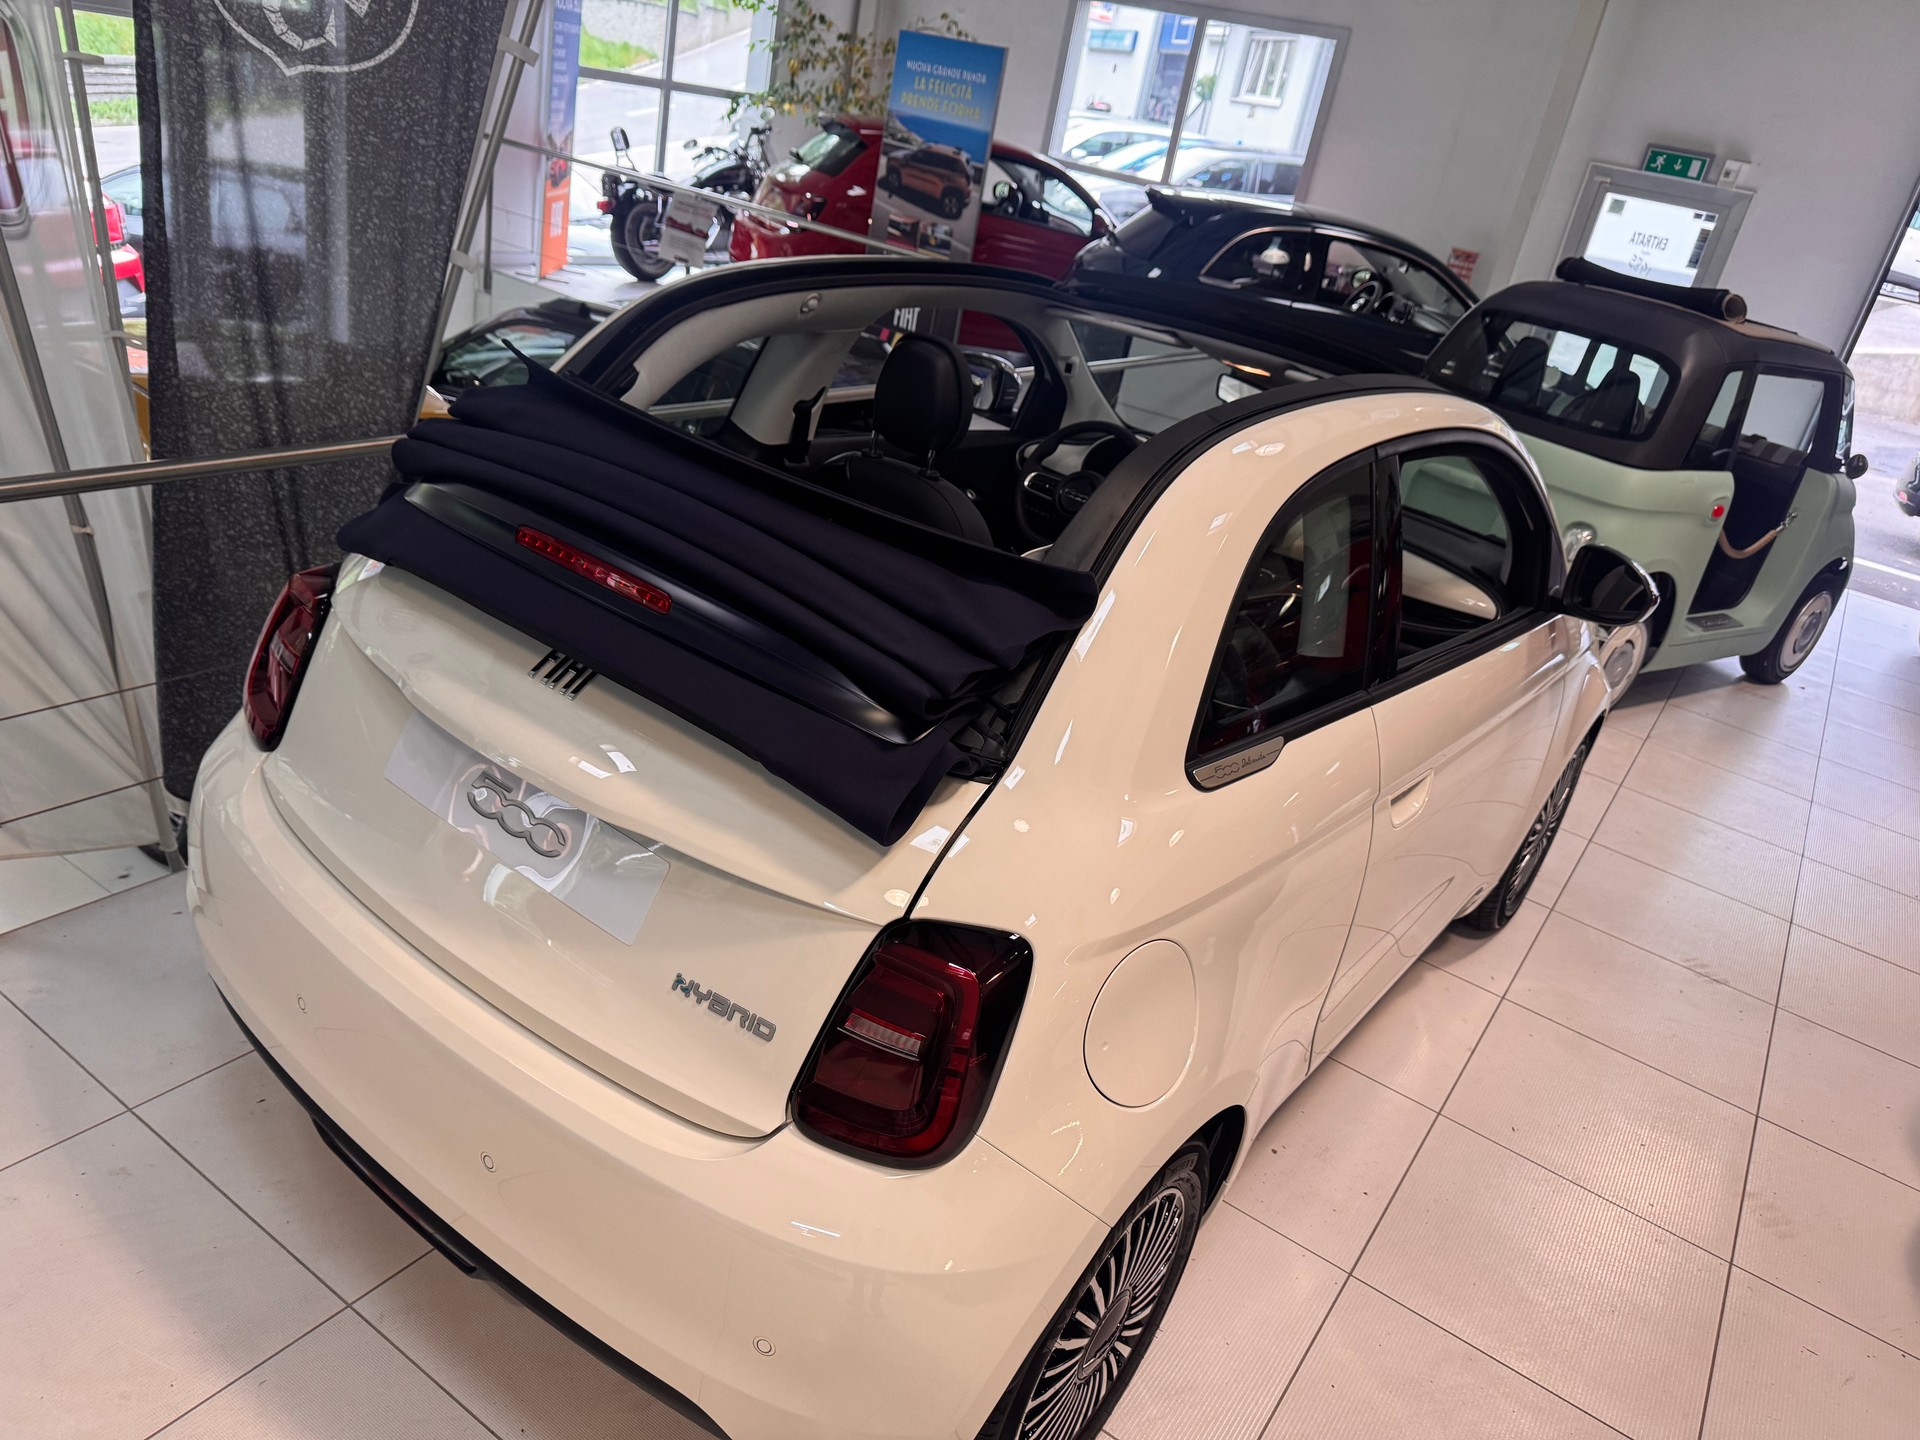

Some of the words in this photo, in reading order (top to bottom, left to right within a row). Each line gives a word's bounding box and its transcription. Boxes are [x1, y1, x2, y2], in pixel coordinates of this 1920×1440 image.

[914, 75, 926, 90] LA
[1215, 762, 1240, 778] 500
[467, 770, 566, 858] 500
[671, 972, 777, 1042] HYBRID
